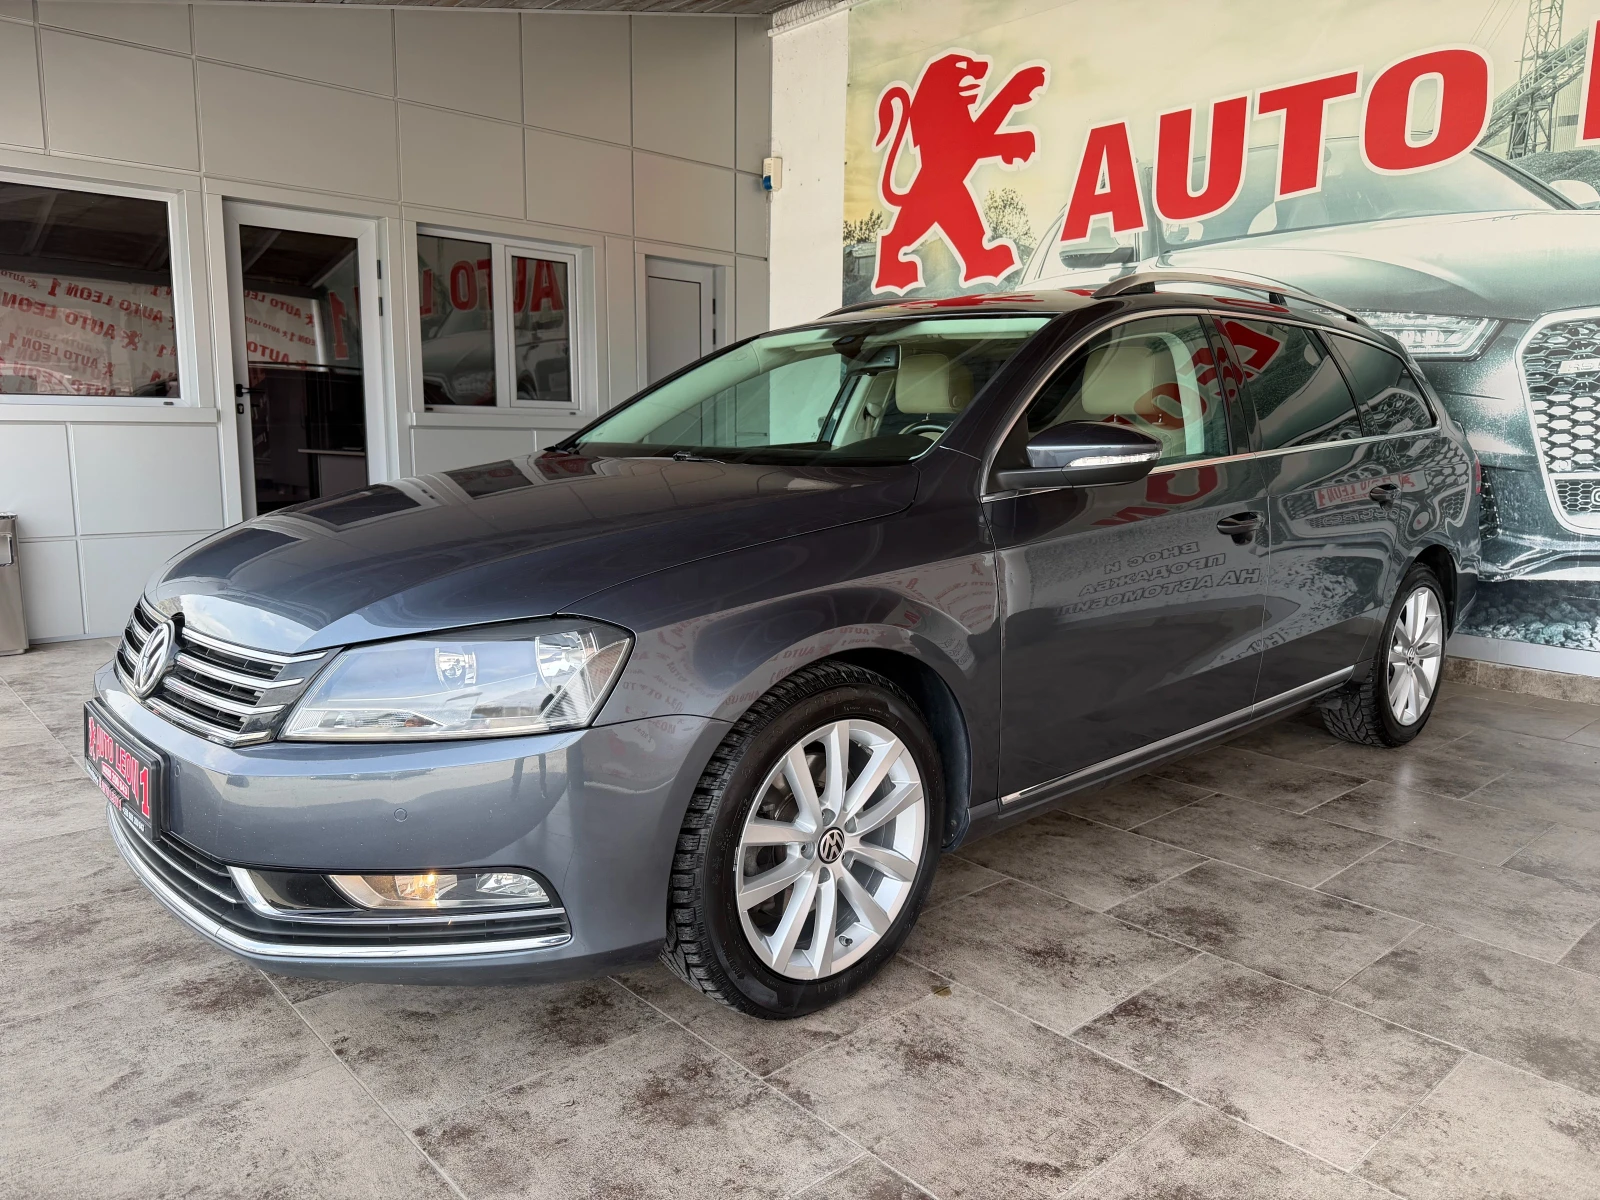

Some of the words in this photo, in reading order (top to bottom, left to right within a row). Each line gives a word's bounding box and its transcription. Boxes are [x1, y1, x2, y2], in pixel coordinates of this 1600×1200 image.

[1060, 48, 1489, 243] AUTO
[96, 724, 114, 763] AUTO
[115, 743, 139, 805] LEON
[140, 766, 150, 819] 1
